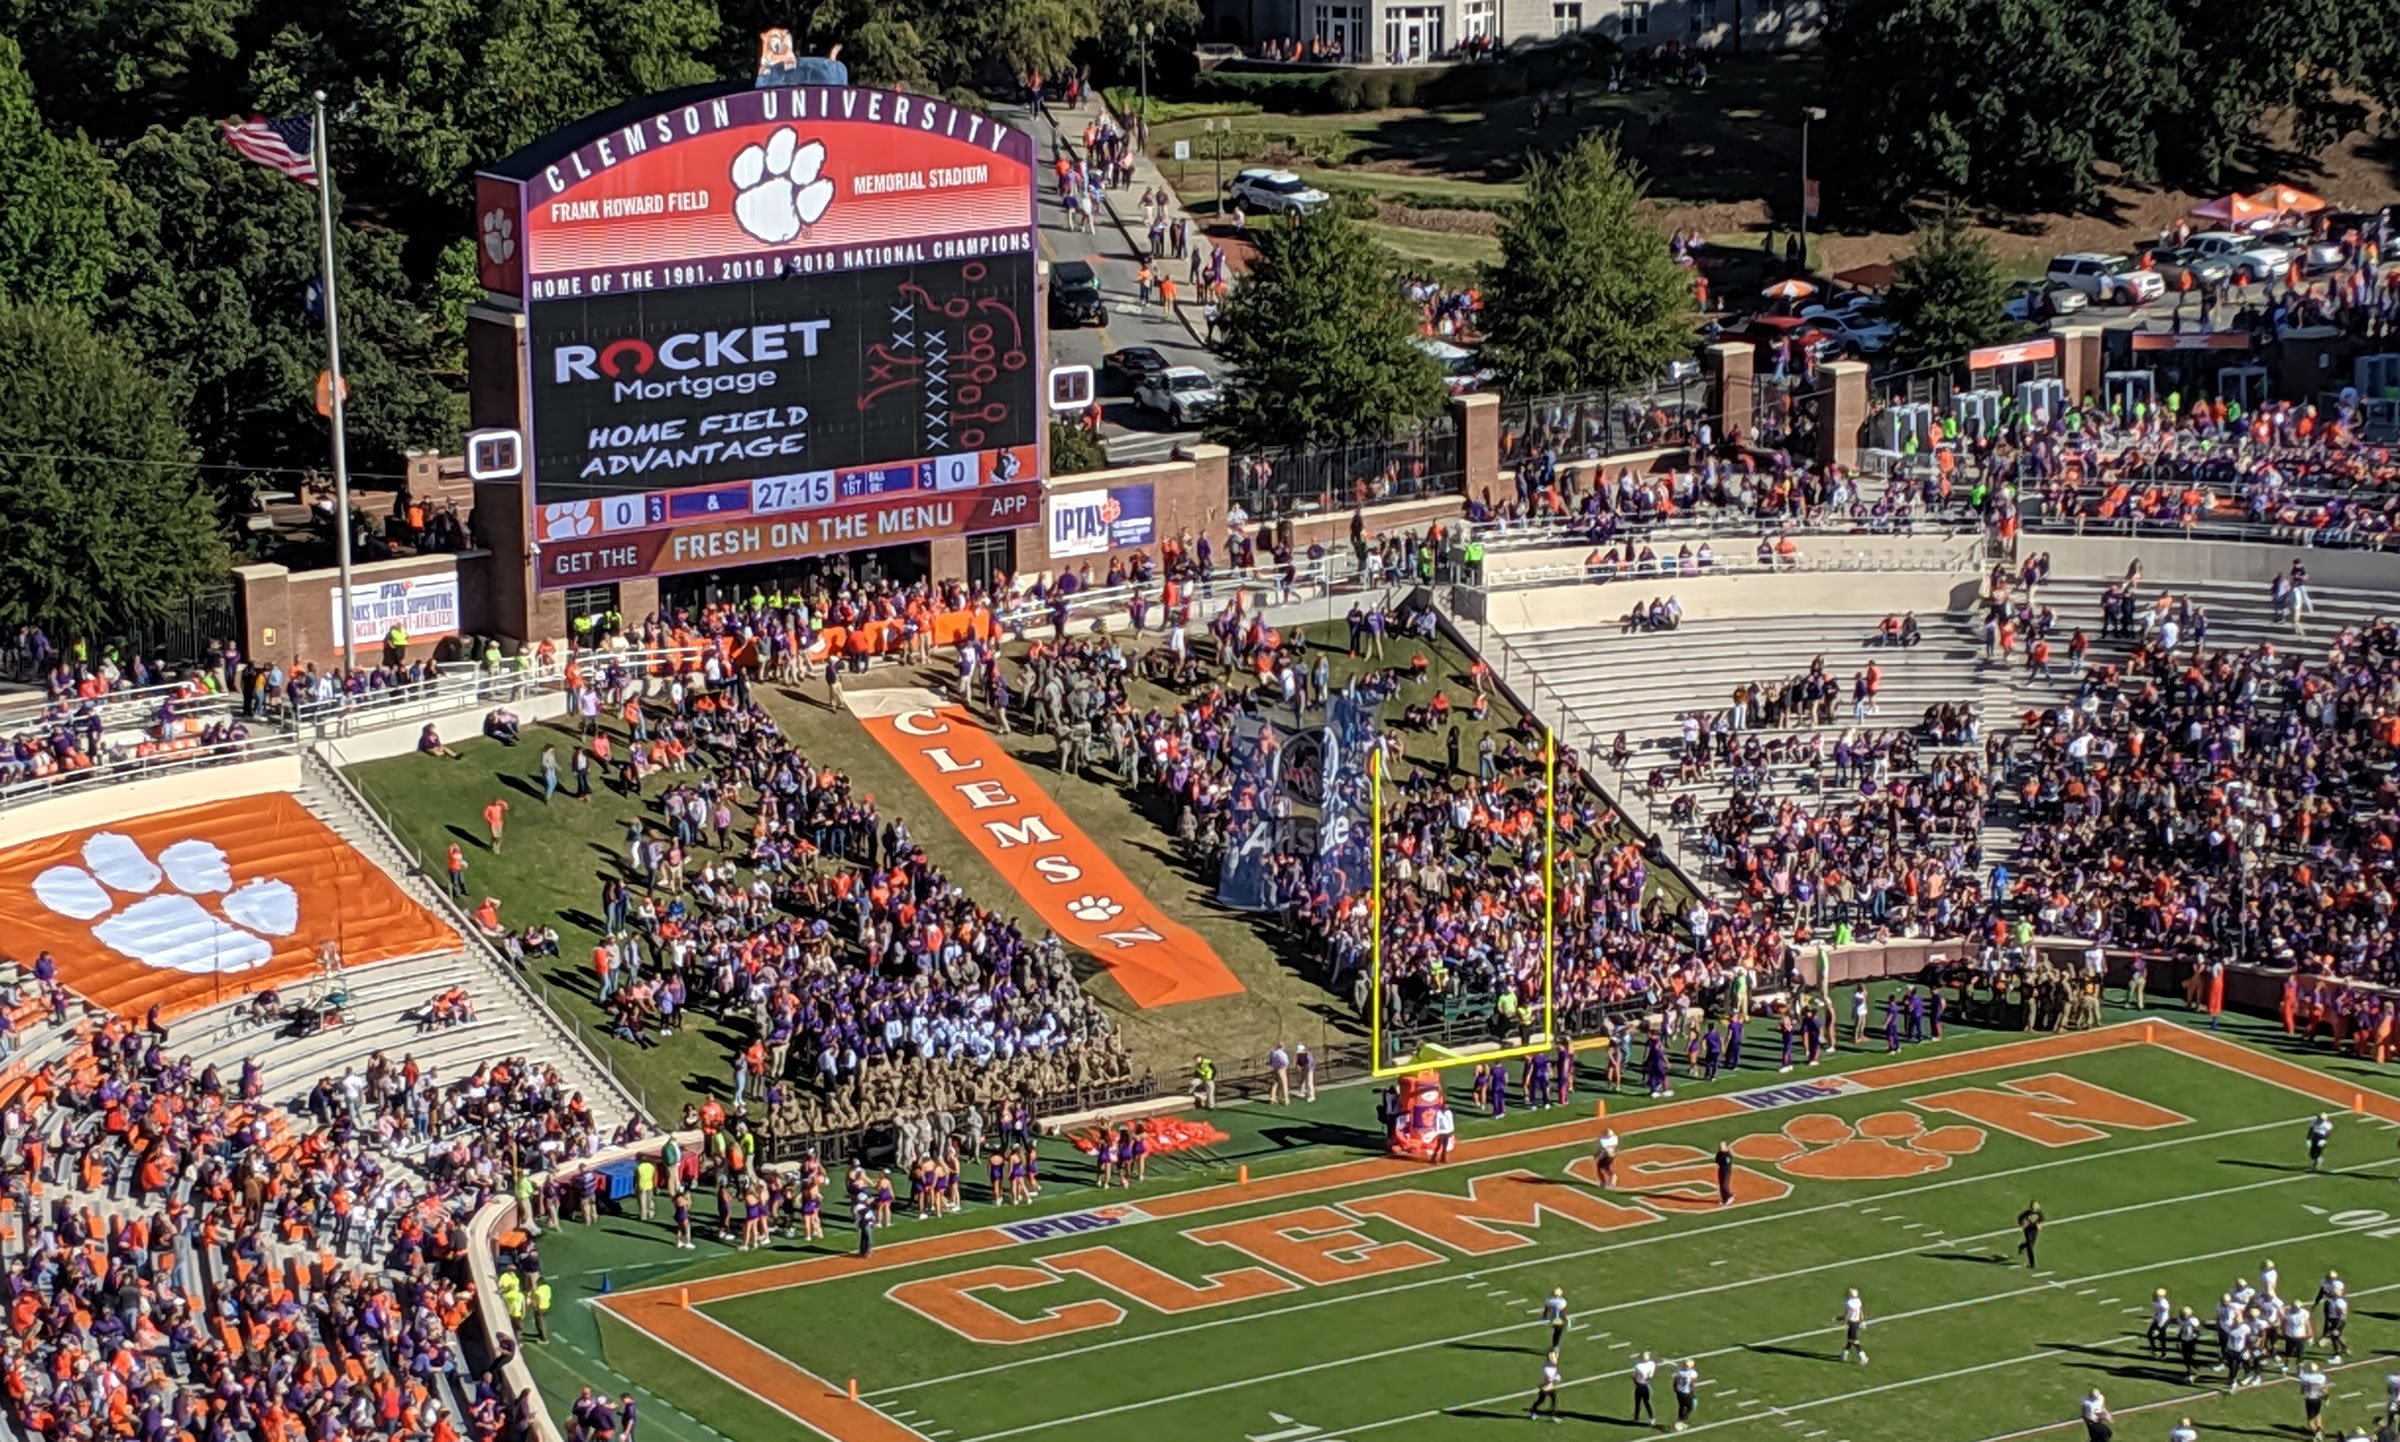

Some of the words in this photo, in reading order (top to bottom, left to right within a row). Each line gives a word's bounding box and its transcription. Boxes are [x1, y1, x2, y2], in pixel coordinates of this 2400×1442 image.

[545, 97, 730, 194] CLEMSON
[762, 88, 1007, 152] UNIVERSITY
[853, 171, 924, 195] MEMORIAL
[929, 165, 988, 189] STADIUM
[551, 201, 600, 224] FRANK
[603, 195, 664, 219] HOWARD
[668, 190, 709, 213] FIELD
[531, 276, 582, 299] HOME
[591, 273, 612, 293] OF
[621, 269, 654, 289] THE
[774, 255, 784, 275] &
[793, 251, 834, 273] 2018
[843, 243, 925, 268] NATIONAL
[933, 231, 1031, 258] CHAMPIONS
[554, 319, 831, 384] ROCKET
[614, 370, 777, 404] Mortgage
[588, 418, 687, 450] HOME
[699, 406, 808, 437] FIELD
[579, 433, 807, 479] ADVANTAGE
[923, 471, 933, 488] 3
[951, 461, 965, 483] 0
[707, 494, 720, 511] &
[758, 476, 829, 509] 27:15
[991, 494, 1027, 518] APP
[616, 502, 632, 525] 0
[651, 505, 662, 522] 3
[1055, 505, 1106, 543] IPTAS
[674, 527, 760, 562] FRESH
[770, 522, 809, 548] ON
[818, 513, 869, 542] THE
[877, 502, 954, 535] MENU
[556, 551, 593, 574] GET
[599, 545, 638, 568] THE
[1734, 1084, 1842, 1108] IPTAS
[1002, 1213, 1121, 1240] IPTAS
